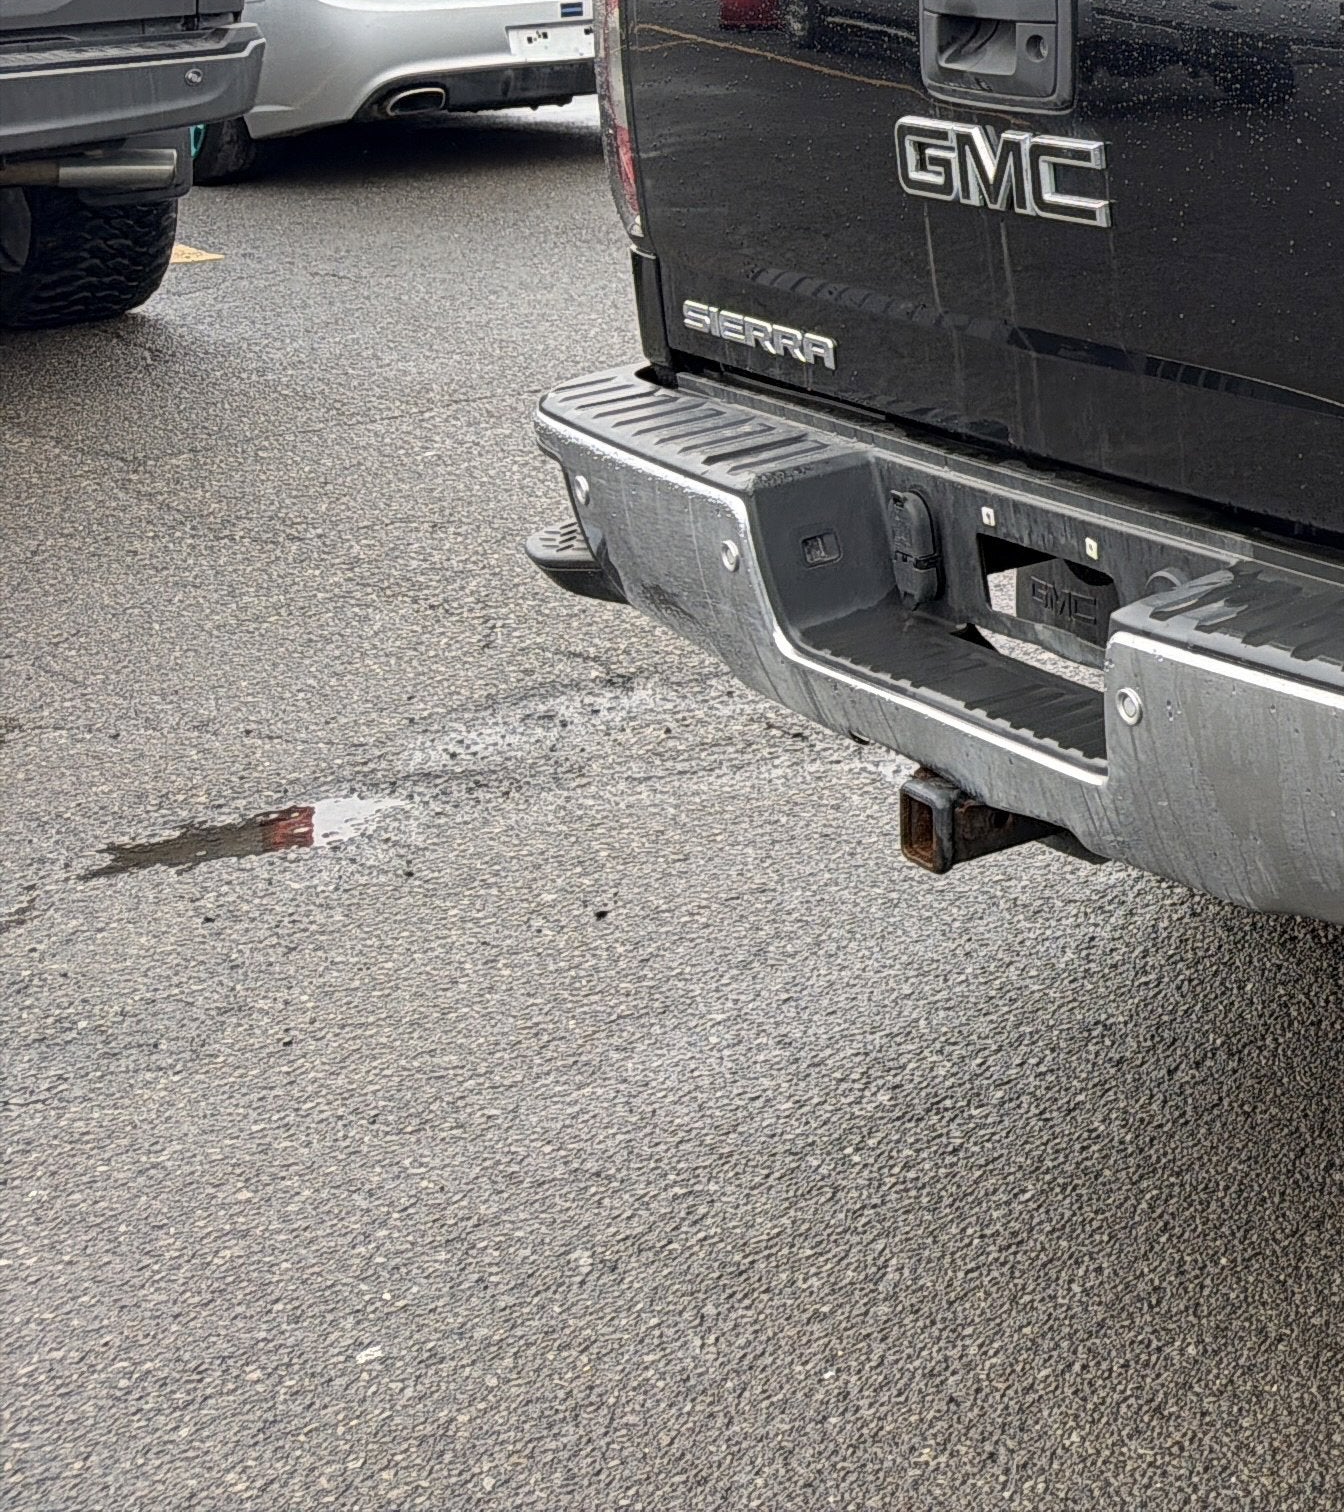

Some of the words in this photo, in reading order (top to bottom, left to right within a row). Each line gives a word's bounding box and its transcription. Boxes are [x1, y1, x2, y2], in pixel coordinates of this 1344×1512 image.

[895, 115, 1113, 228] GMC
[683, 299, 836, 370] SIERRA
[1030, 575, 1097, 625] GMC
